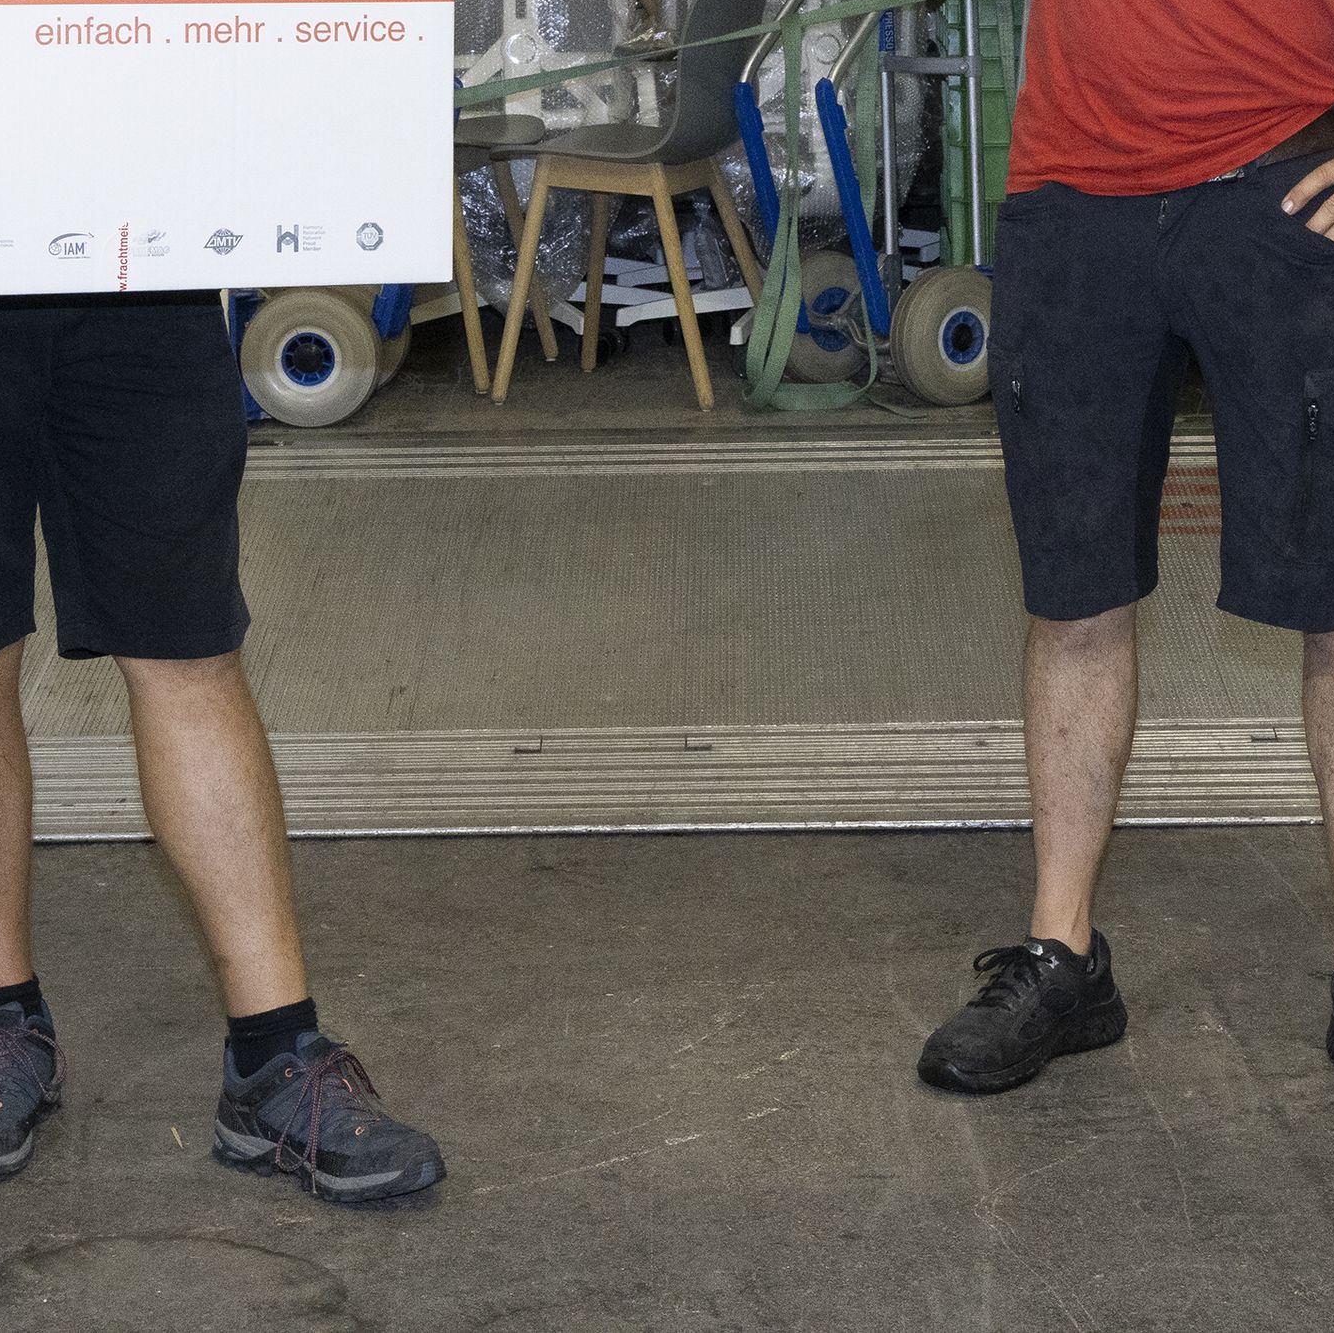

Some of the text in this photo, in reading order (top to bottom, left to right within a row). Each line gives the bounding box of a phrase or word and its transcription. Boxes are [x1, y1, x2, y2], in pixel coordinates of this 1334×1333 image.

[35, 17, 151, 47] einfach
[185, 17, 265, 45] mehr
[296, 16, 405, 43] service
[64, 242, 85, 255] IAM
